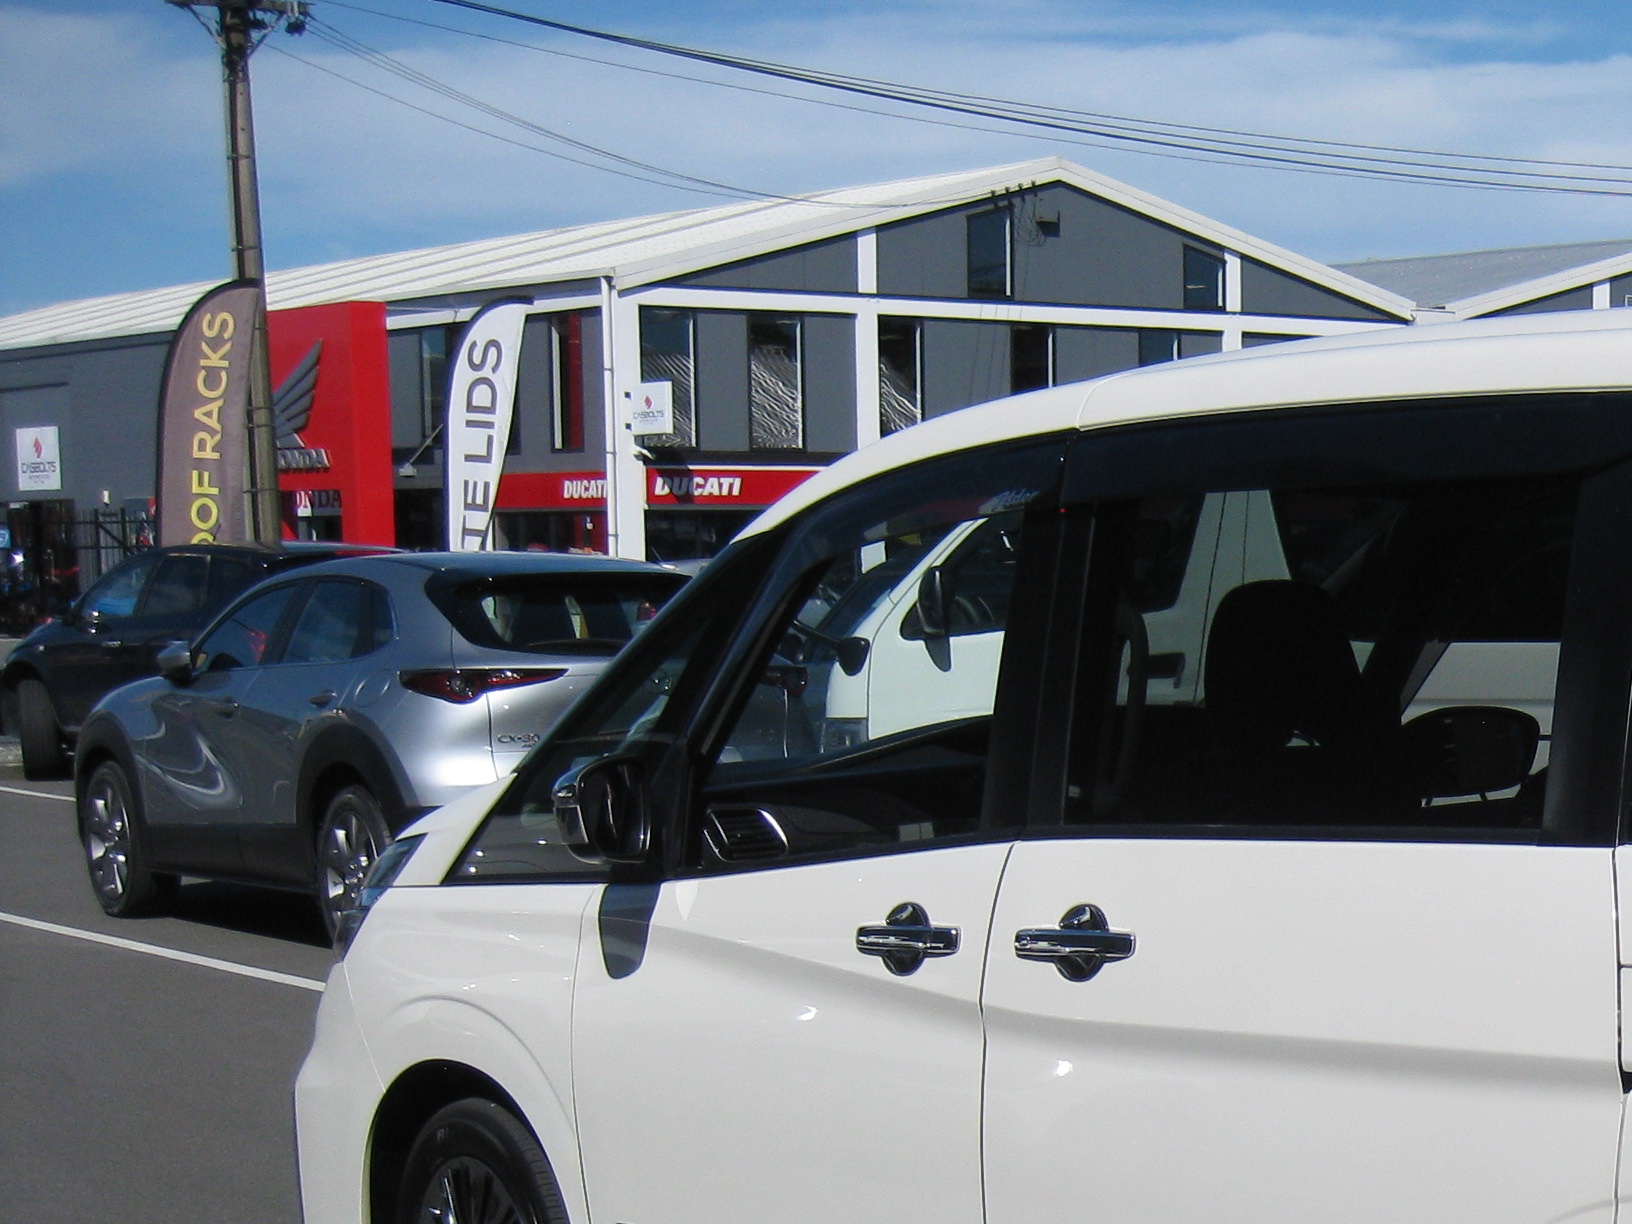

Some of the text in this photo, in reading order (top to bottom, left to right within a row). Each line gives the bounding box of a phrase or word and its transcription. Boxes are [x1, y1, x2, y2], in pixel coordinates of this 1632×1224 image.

[193, 311, 235, 460] RACKS
[464, 338, 502, 465] LIDS
[653, 475, 743, 496] DUCATI
